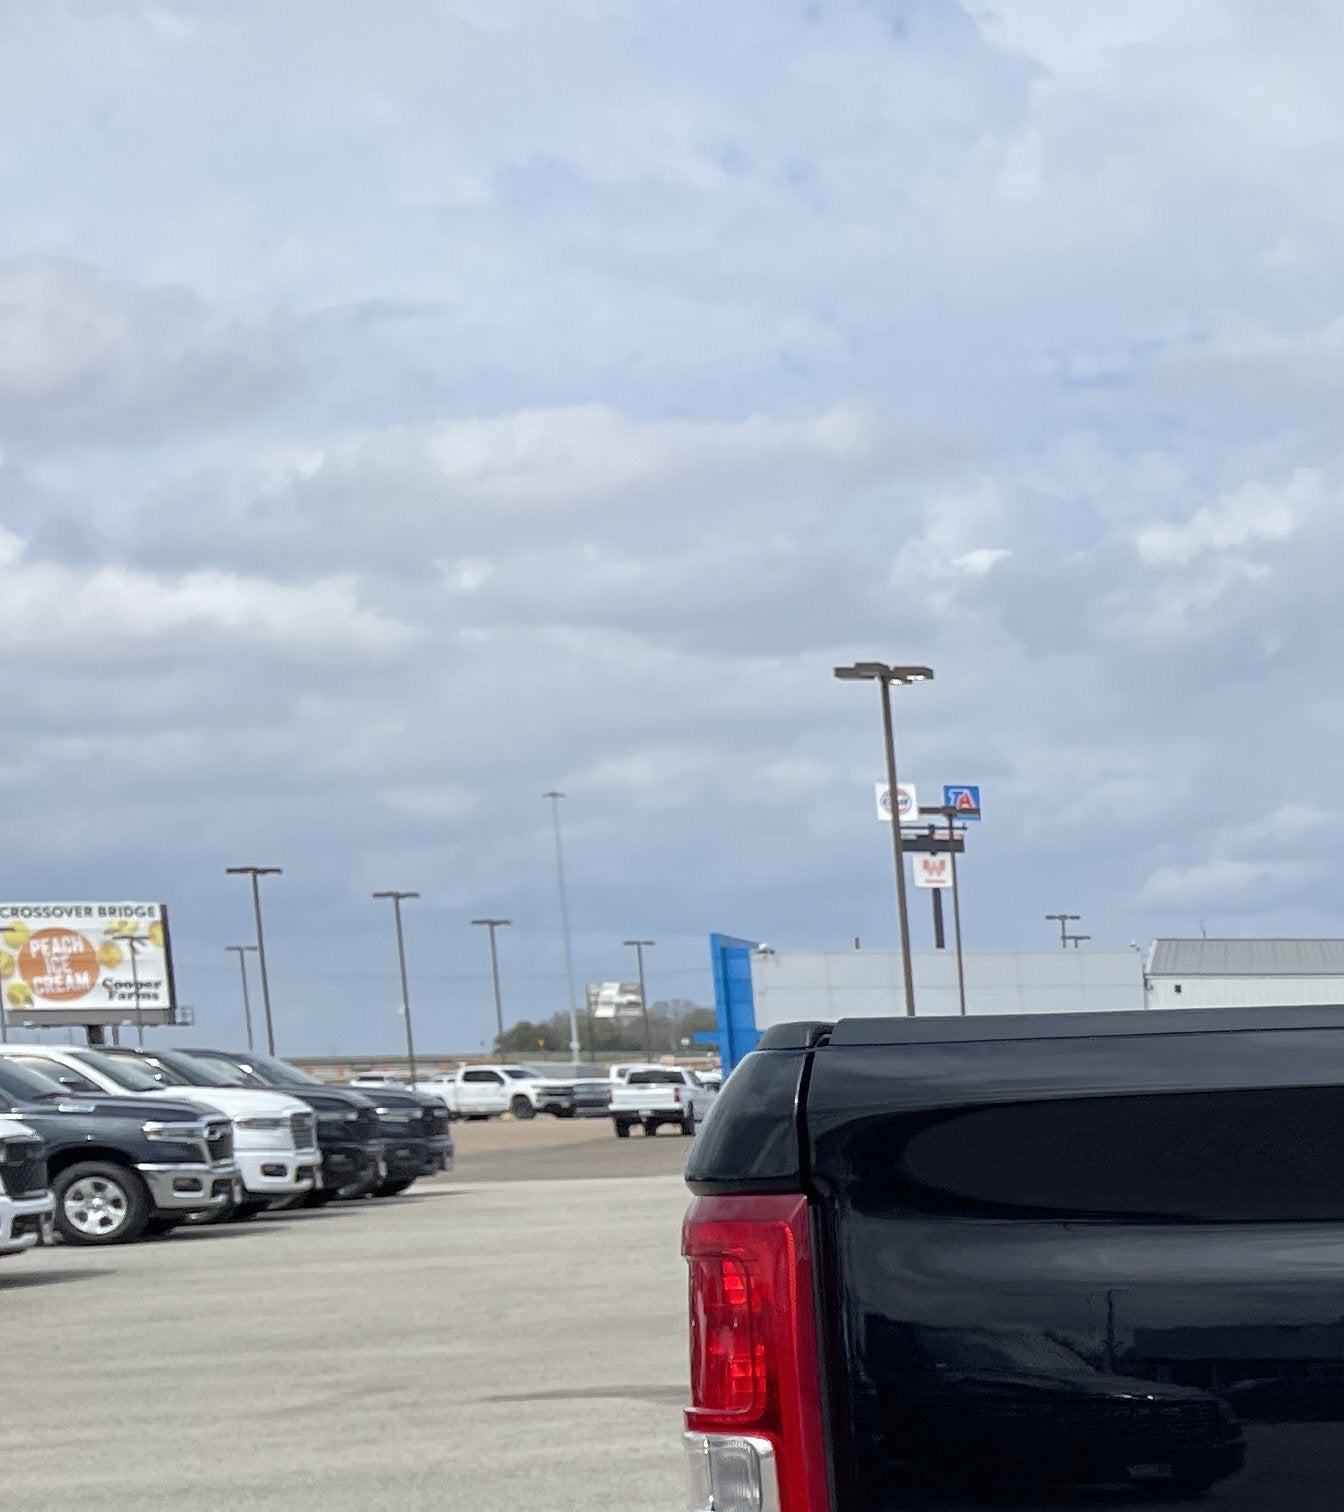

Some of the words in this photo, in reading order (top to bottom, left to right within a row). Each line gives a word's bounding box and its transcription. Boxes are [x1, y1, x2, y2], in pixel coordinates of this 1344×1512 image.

[0, 906, 92, 919] CROSSOVER
[98, 906, 156, 918] BRIDGE
[29, 936, 84, 958] PEACH
[31, 971, 91, 994] CREAM
